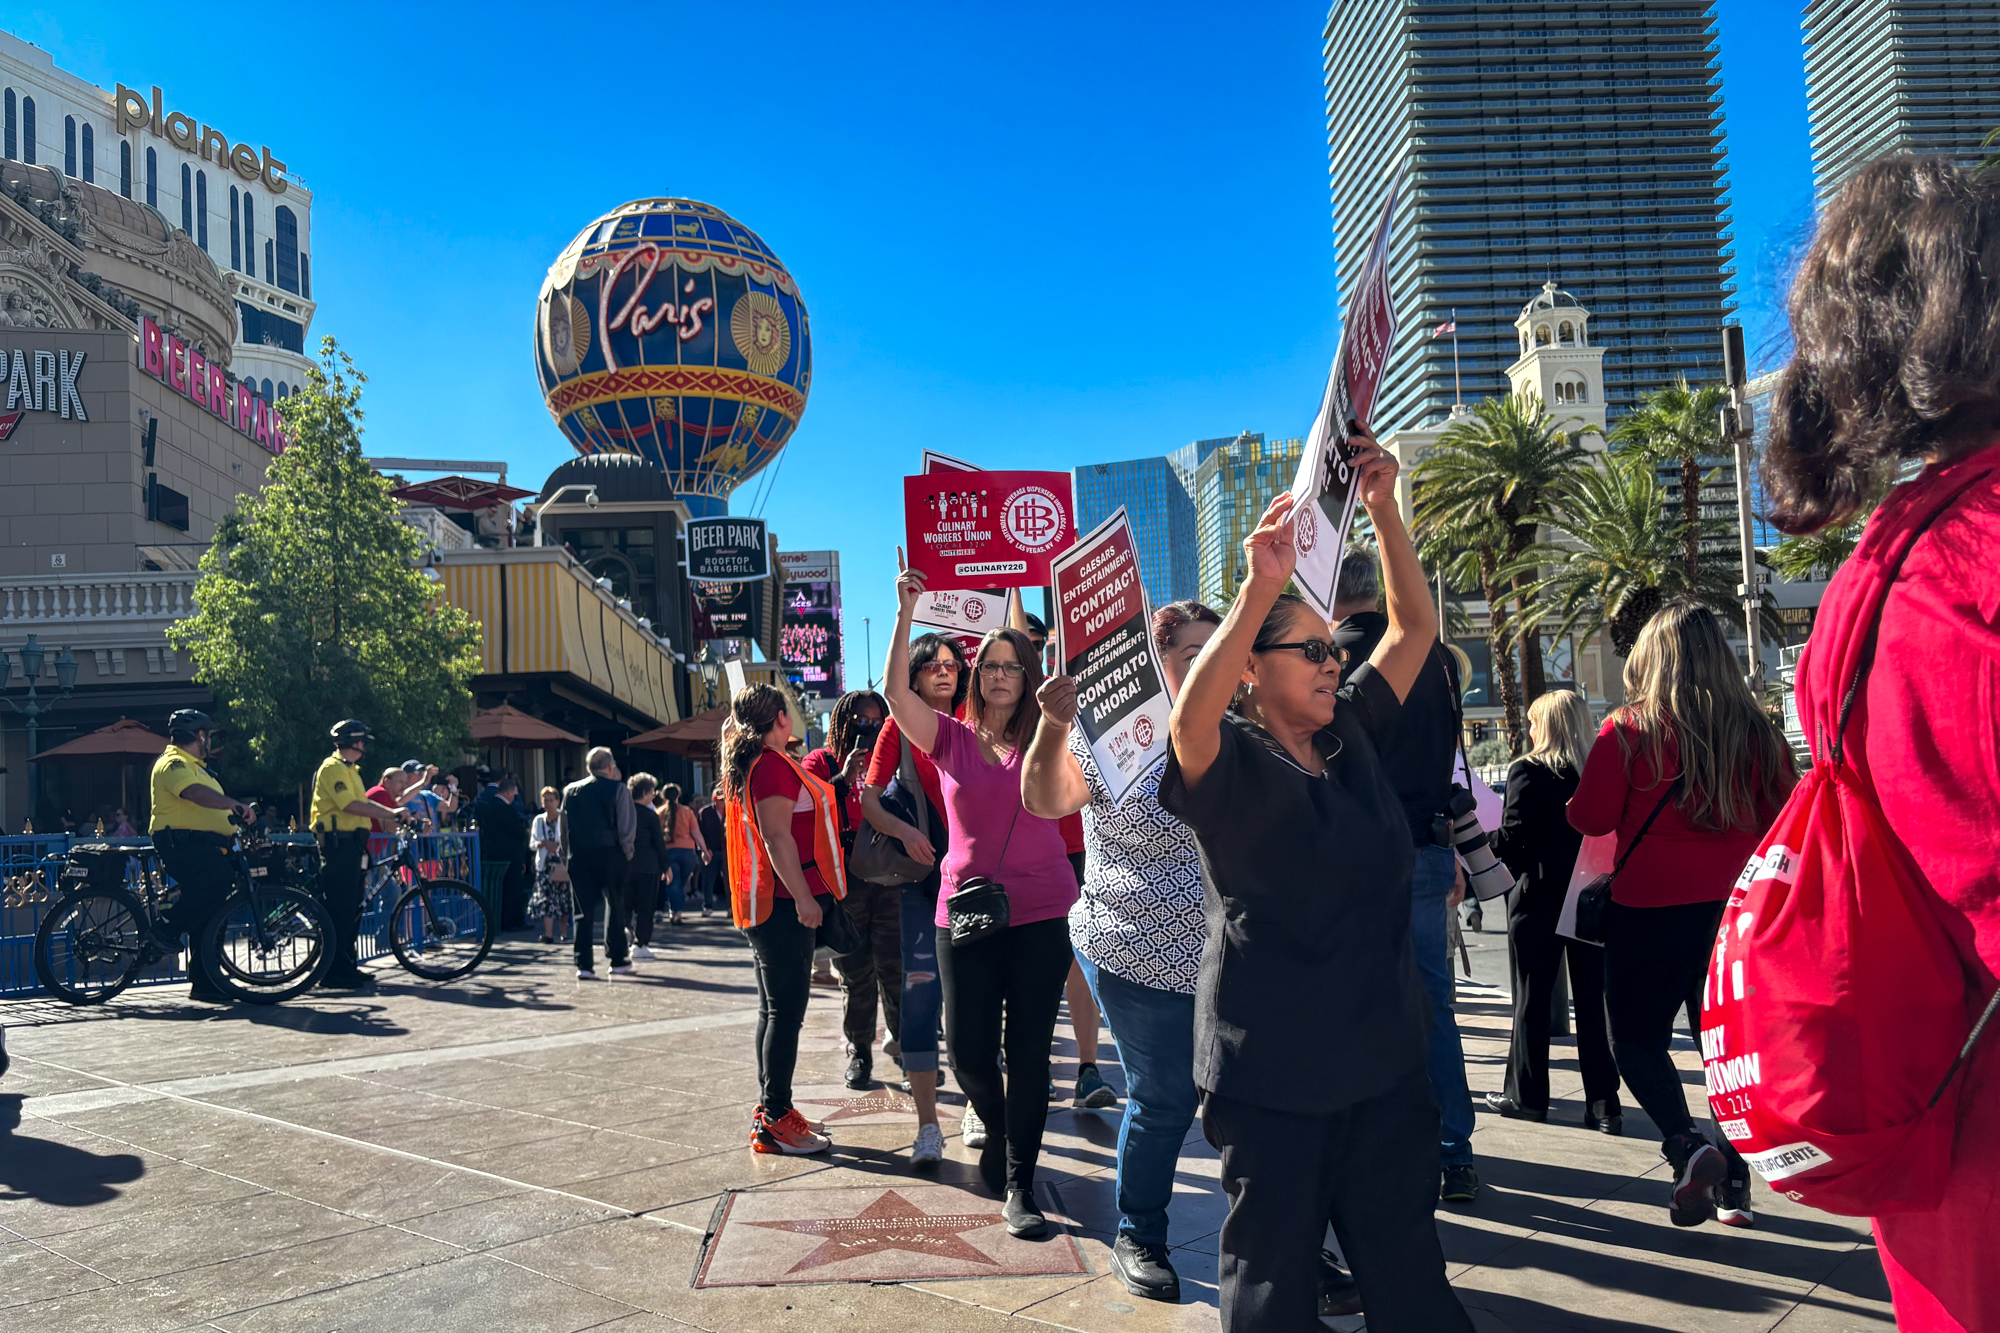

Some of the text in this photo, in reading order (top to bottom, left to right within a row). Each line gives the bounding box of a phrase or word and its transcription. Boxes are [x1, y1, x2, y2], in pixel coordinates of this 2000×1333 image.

[116, 82, 287, 194] planet
[599, 242, 713, 375] Paris
[143, 316, 292, 456] BEER PAR
[1003, 486, 1026, 507] BEVERAGE
[1053, 498, 1065, 514] UNION
[692, 524, 760, 551] BEER PARK
[923, 530, 991, 544] WORKERS UNION
[1015, 542, 1026, 552] LAS
[1045, 541, 1054, 550] NV
[705, 556, 750, 565] ROOFTOP
[958, 563, 1024, 575] @CULINARY226
[1063, 549, 1131, 604] ENTERTAINMENT:
[1080, 545, 1116, 578] CAESARS
[1070, 566, 1136, 623] CONTRACT
[1085, 596, 1126, 636] NOW!!!
[1087, 629, 1128, 662] CAESARS
[1077, 651, 1148, 709] CONTRATO
[1093, 677, 1142, 723] AHORA!
[1727, 1093, 1752, 1115] 226
[886, 1234, 947, 1245] Vegas
